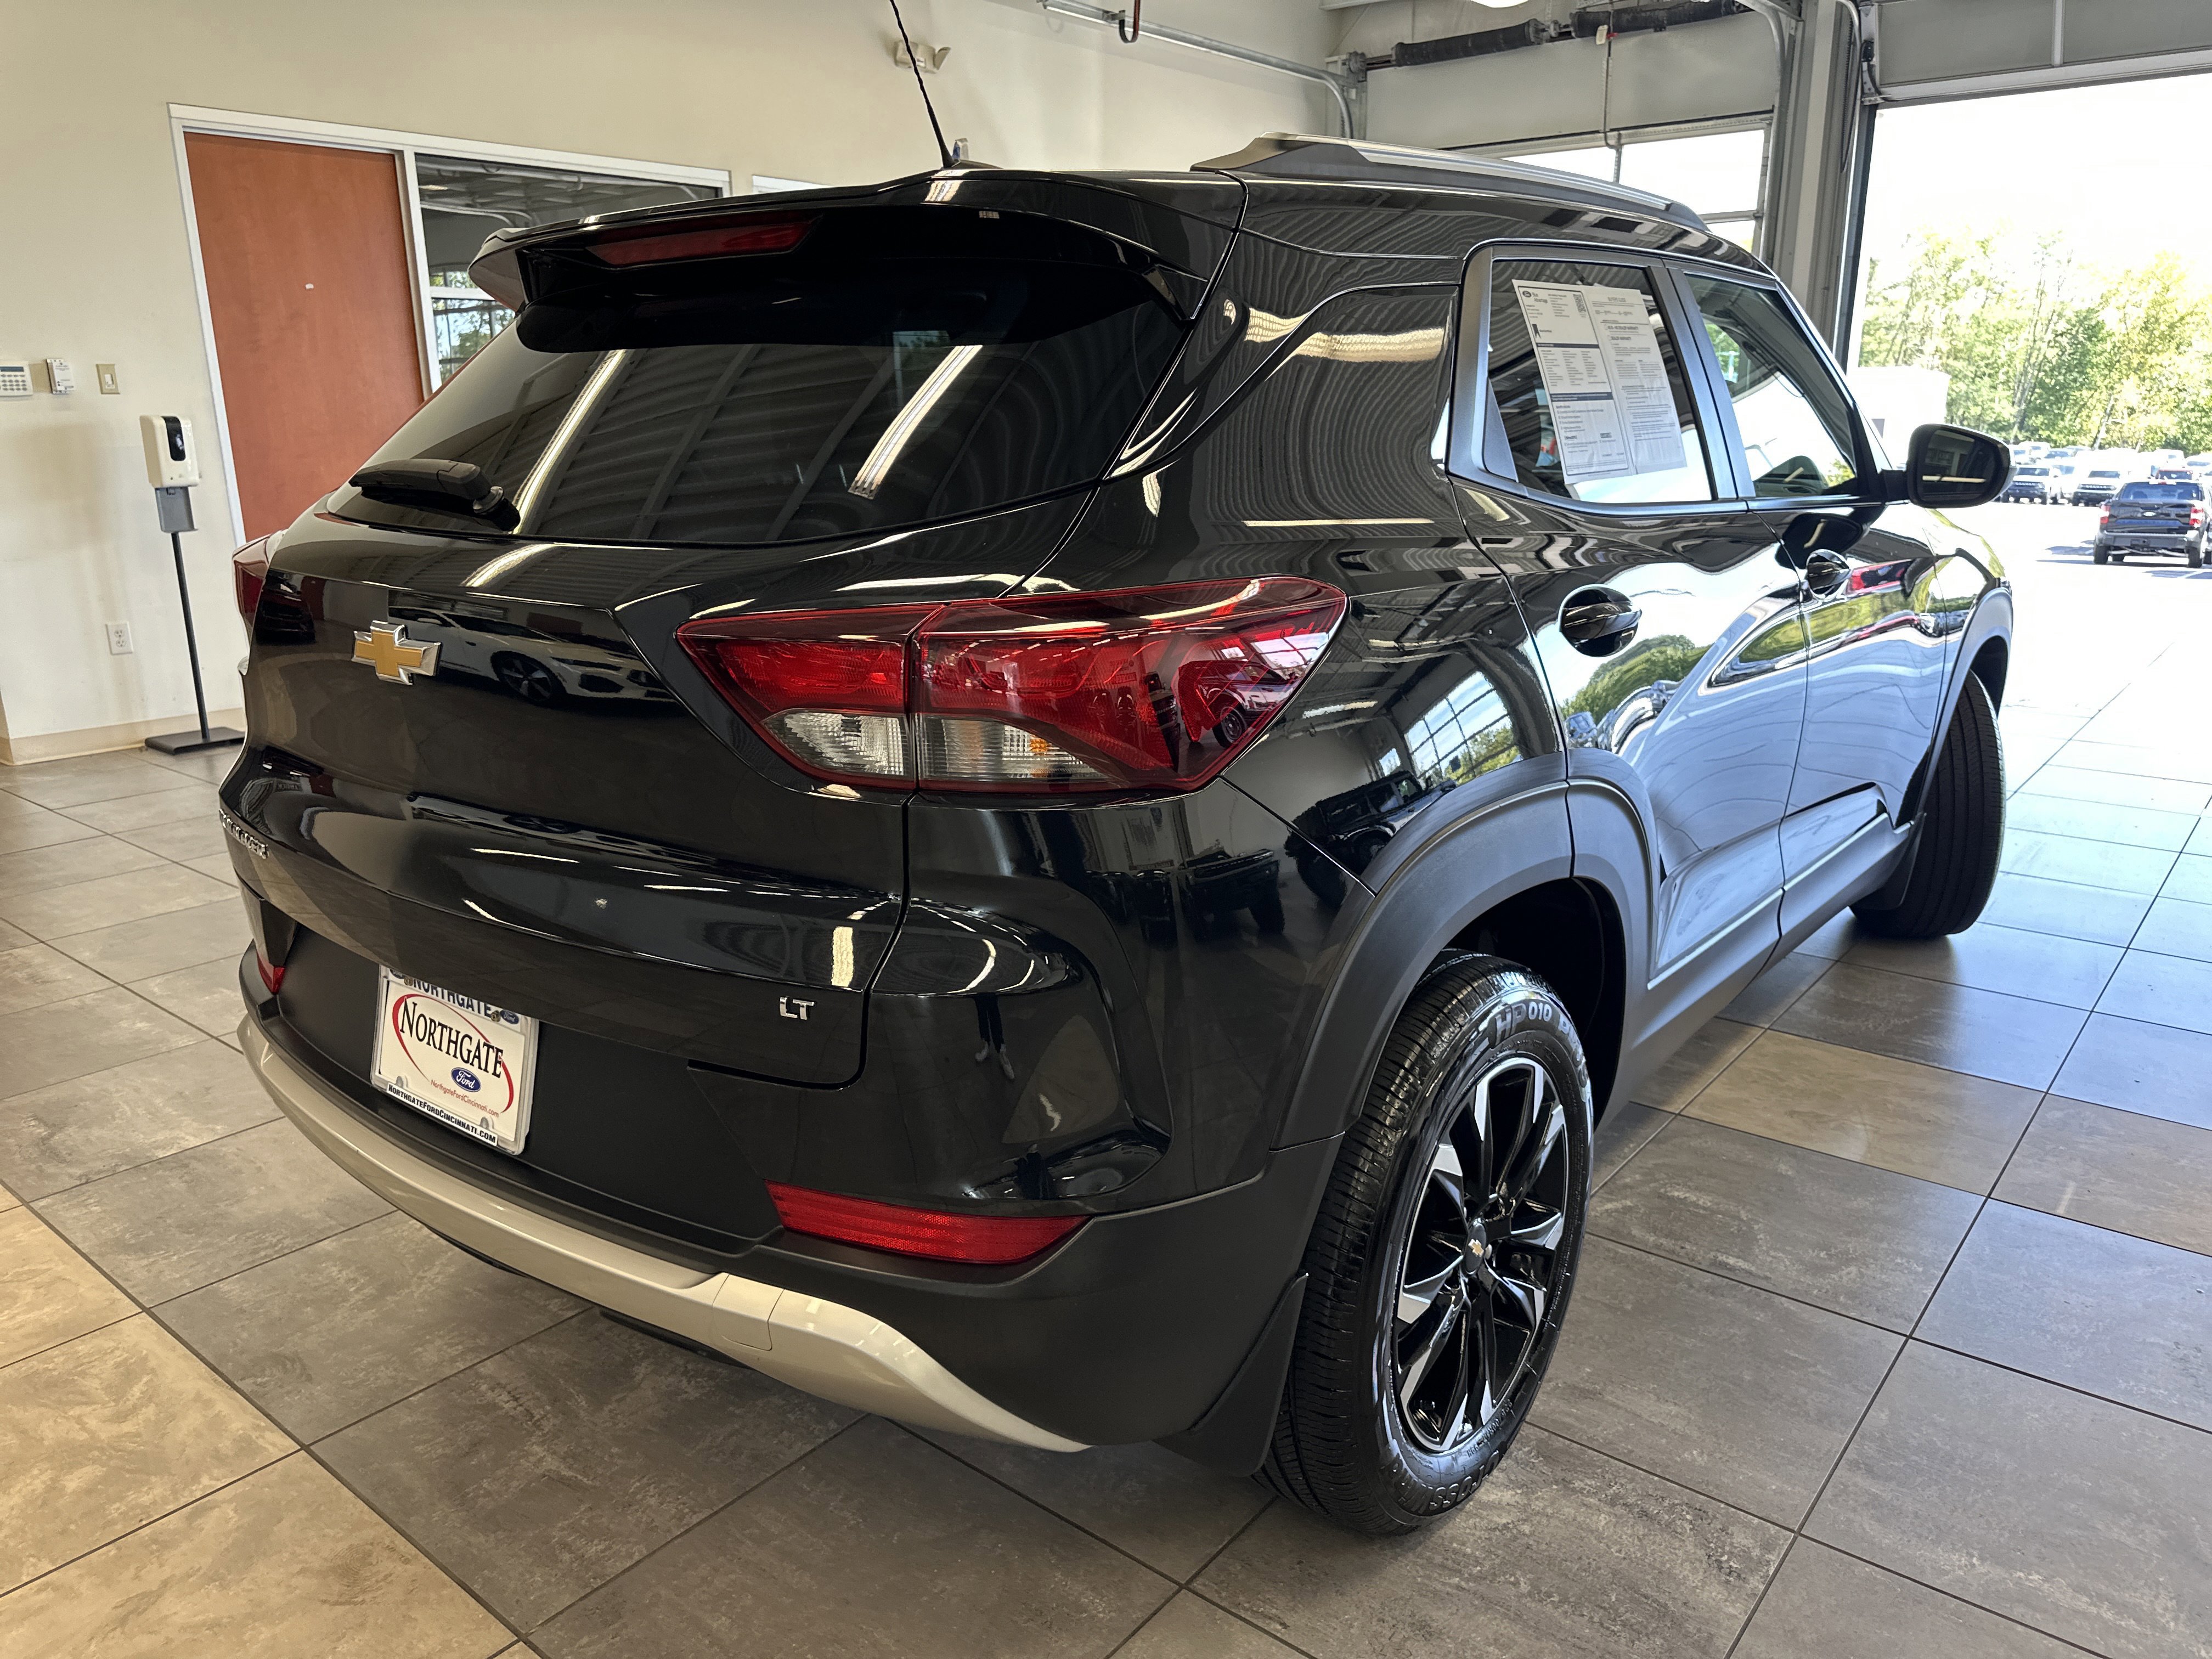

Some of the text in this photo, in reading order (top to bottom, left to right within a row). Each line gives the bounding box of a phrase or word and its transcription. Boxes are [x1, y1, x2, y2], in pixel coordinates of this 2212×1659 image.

[779, 996, 815, 1020] LT
[399, 997, 504, 1079] NORTHGATE
[455, 1069, 477, 1090] Ford
